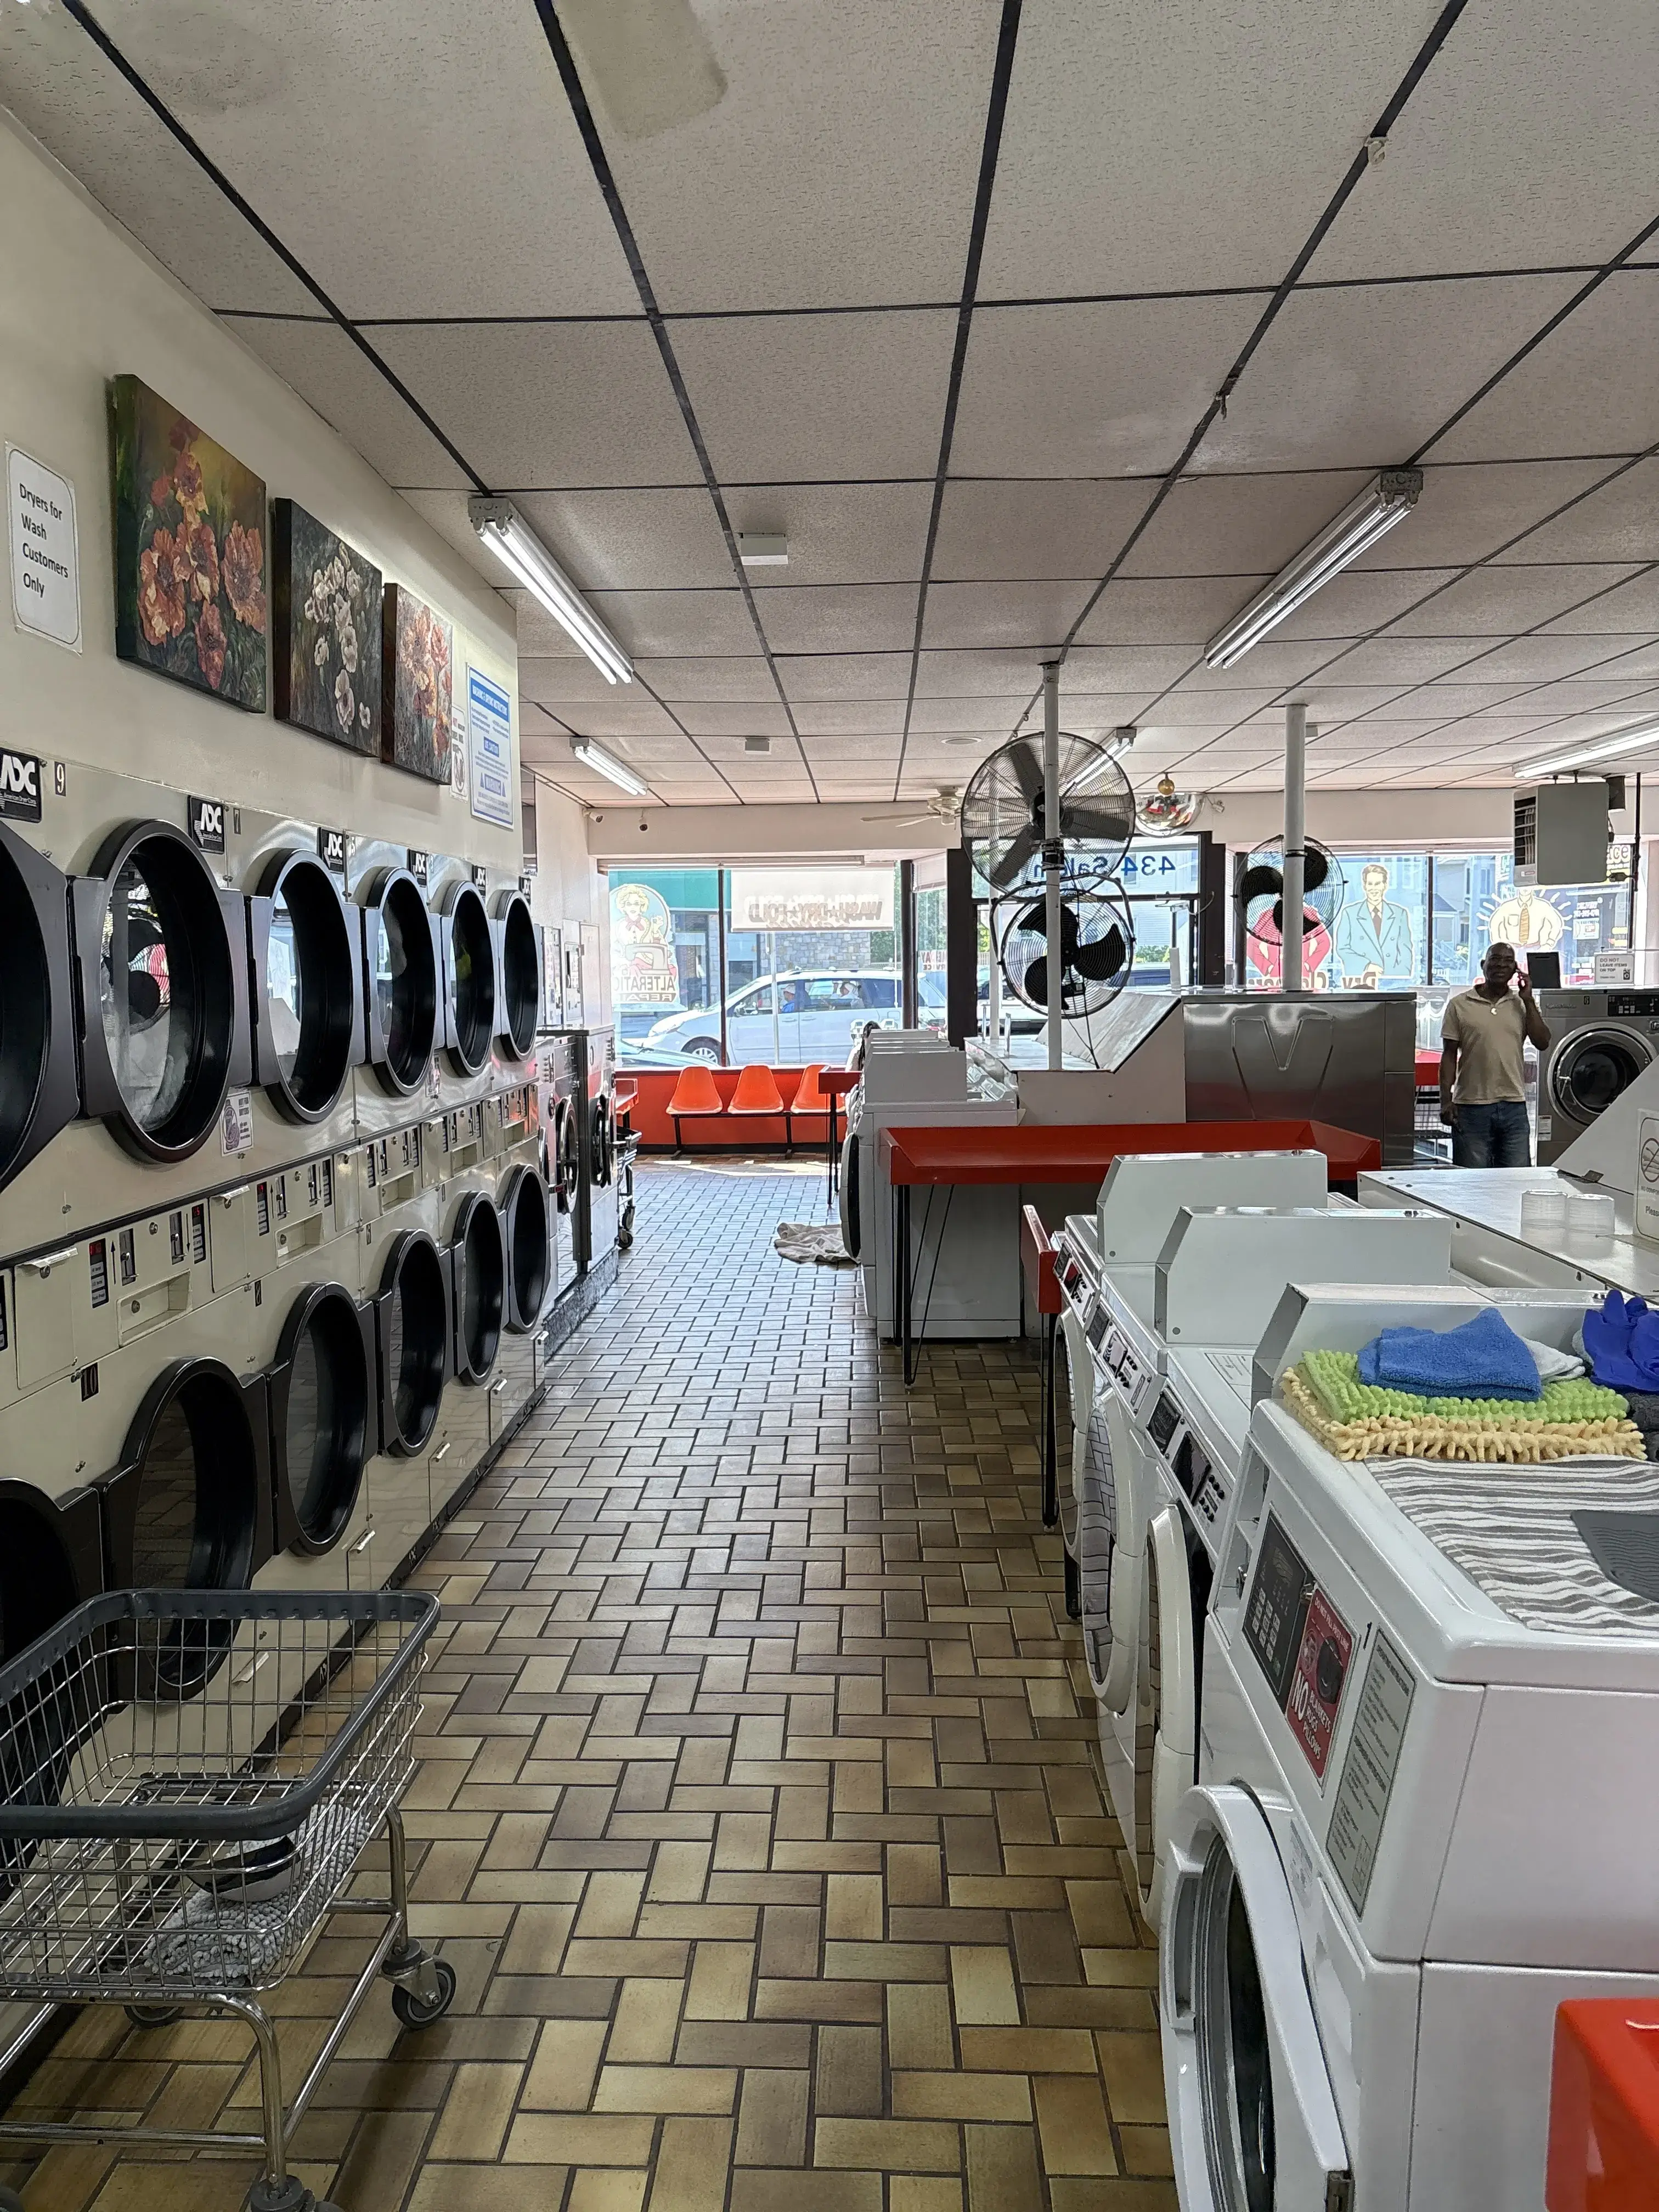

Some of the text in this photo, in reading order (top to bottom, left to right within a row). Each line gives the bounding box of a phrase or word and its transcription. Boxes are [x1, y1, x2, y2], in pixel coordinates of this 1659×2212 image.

[19, 483, 63, 520] Dryers for
[21, 513, 47, 540] Wash
[22, 543, 69, 579] Customers
[23, 572, 45, 597] Only
[1, 754, 36, 796] ADC
[57, 764, 65, 793] 9
[201, 803, 222, 834] ADC
[234, 810, 240, 833] 7
[328, 833, 342, 858] ADC
[256, 1283, 261, 1304] 8
[83, 1366, 97, 1398] 10
[1291, 1669, 1308, 1721] NO
[1305, 1705, 1318, 1733] RUGS
[1310, 1690, 1331, 1733] BLANKETS
[1302, 1720, 1322, 1760] PILLOWS
